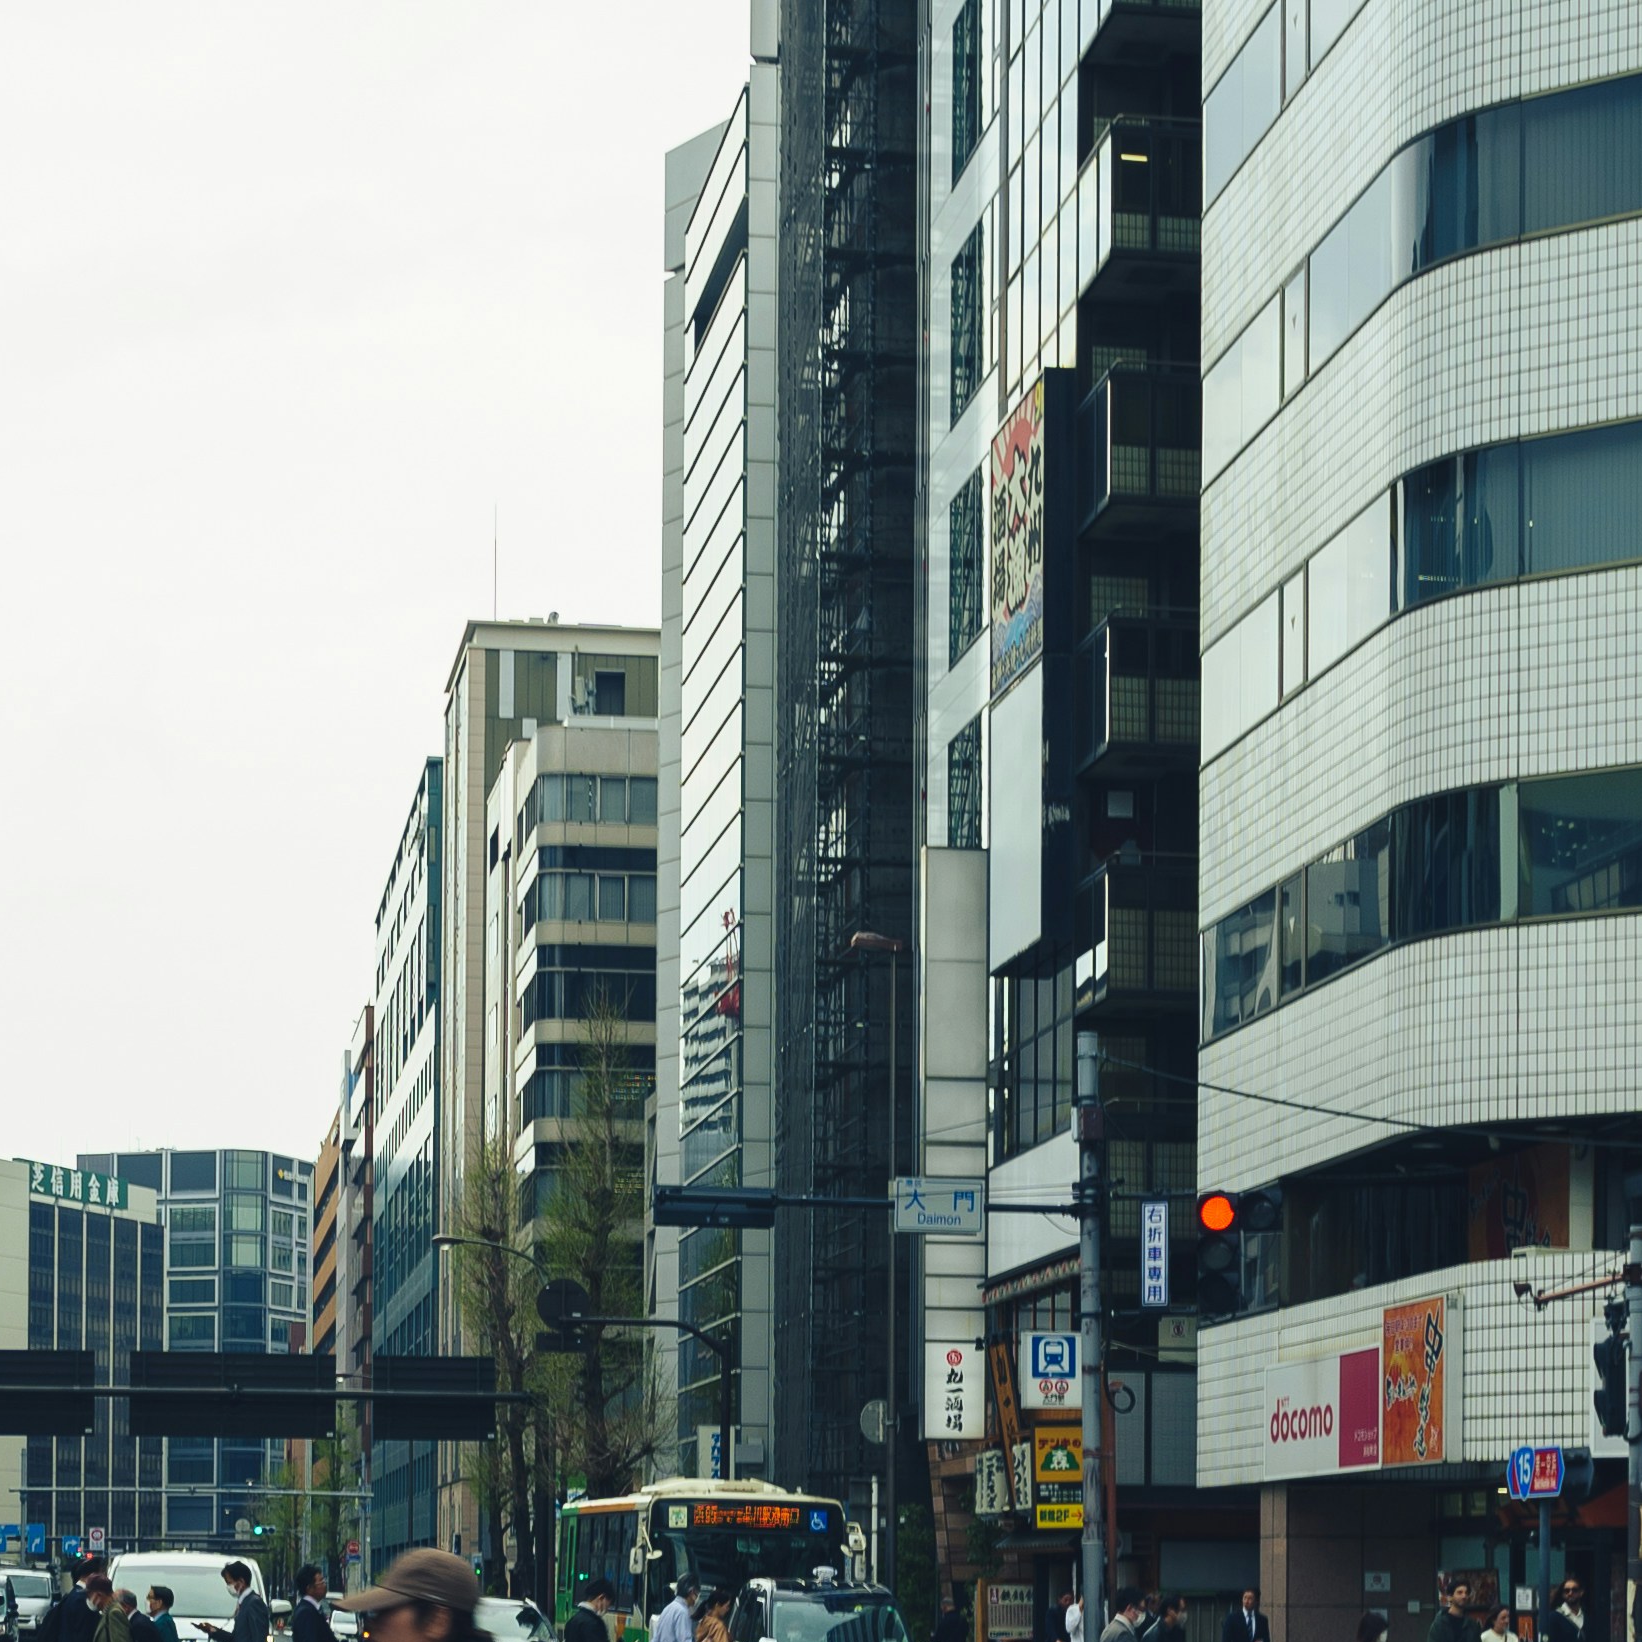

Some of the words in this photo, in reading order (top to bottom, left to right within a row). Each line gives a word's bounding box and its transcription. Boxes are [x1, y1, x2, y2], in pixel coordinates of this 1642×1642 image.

[1007, 443, 1027, 618] 大漁
[1027, 443, 1042, 574] 九州
[31, 1162, 119, 1207] 芝信用金庫
[905, 1189, 974, 1213] 大門
[917, 1213, 962, 1226] Daimon
[1147, 1206, 1162, 1302] 右折車専用
[1270, 1399, 1333, 1443] docomo
[1518, 1453, 1530, 1485] 15
